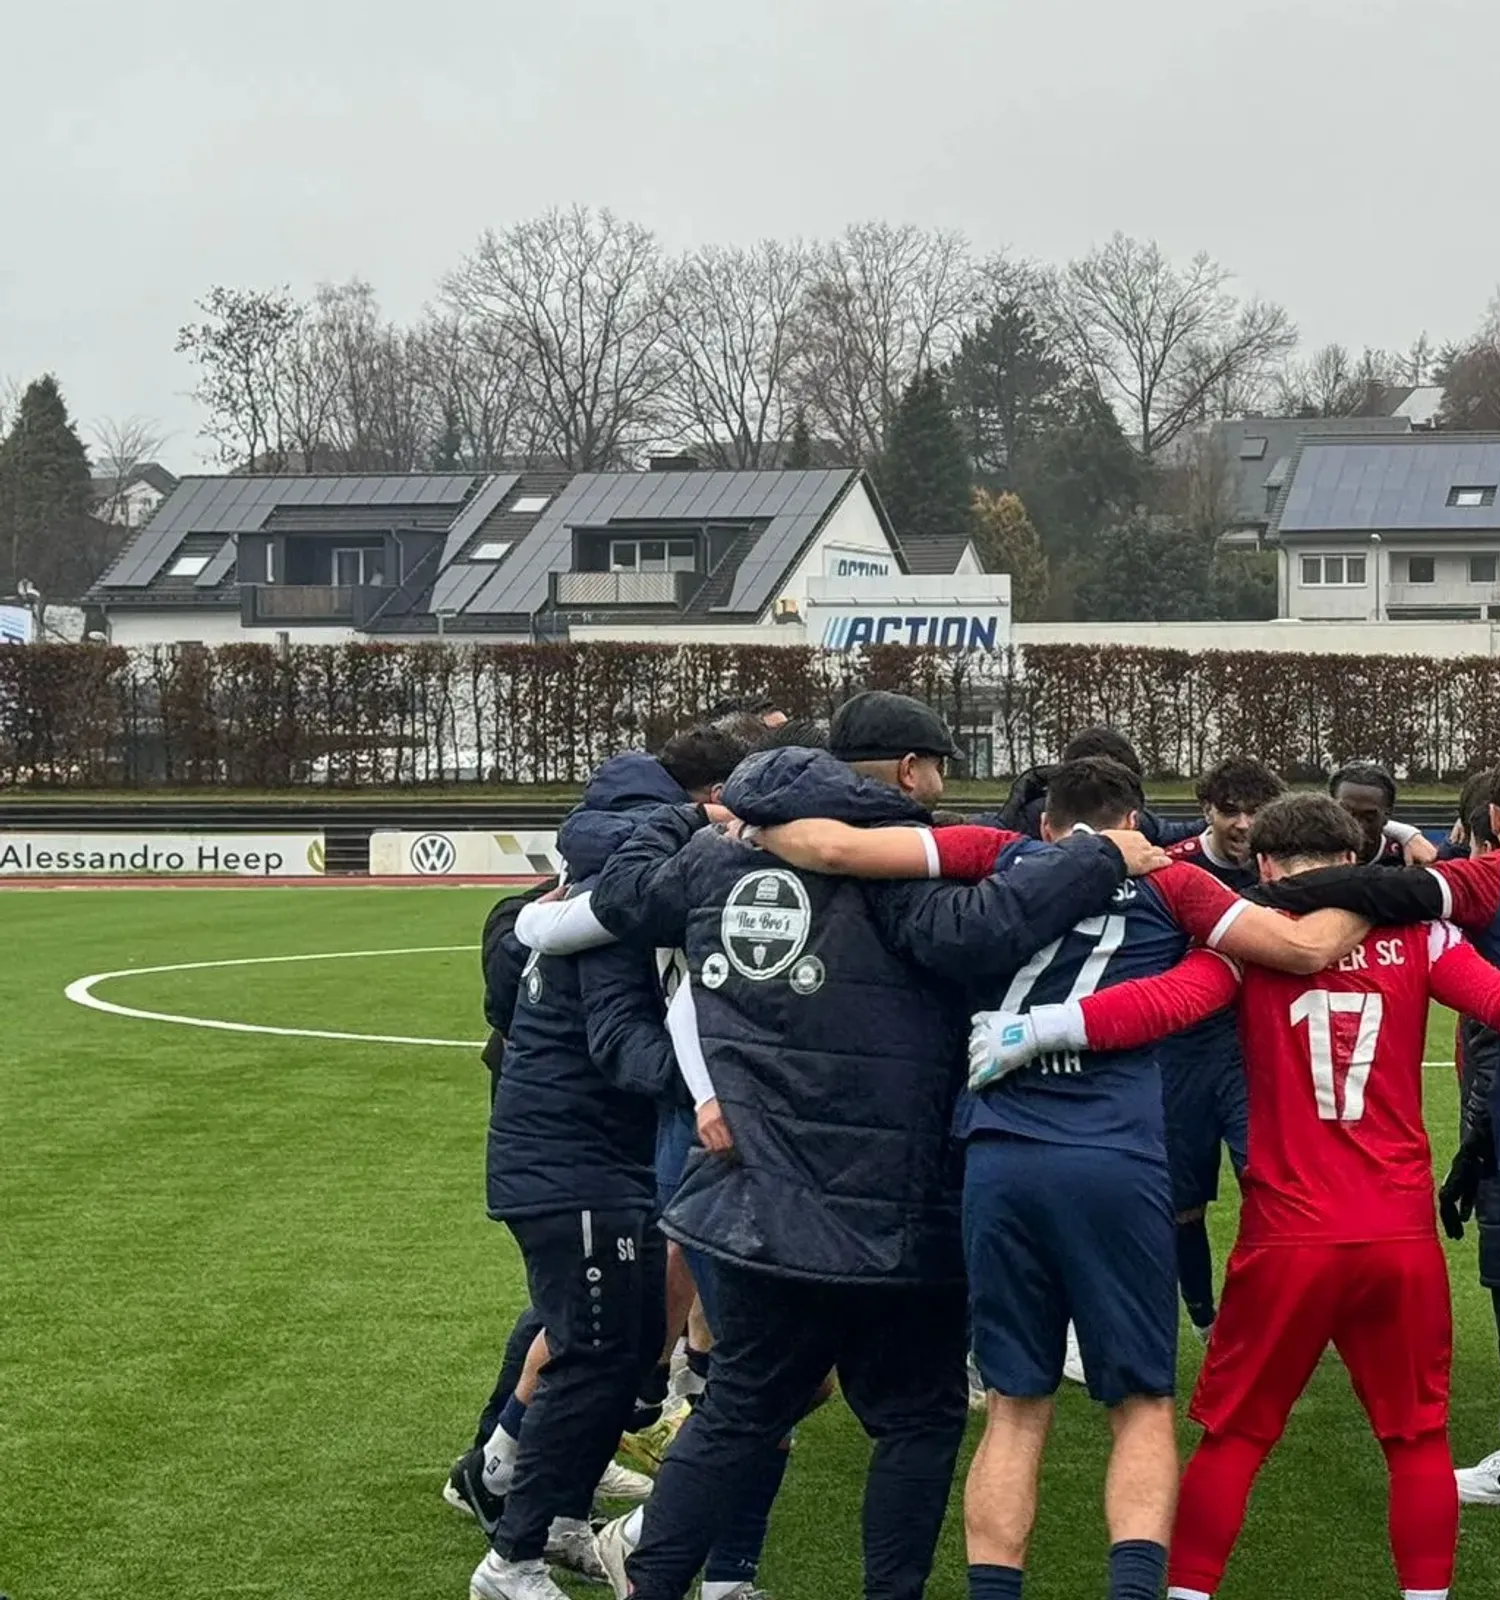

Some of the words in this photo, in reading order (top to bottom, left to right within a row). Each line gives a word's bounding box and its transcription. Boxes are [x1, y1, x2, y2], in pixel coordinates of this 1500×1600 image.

[844, 616, 999, 651] ACTION
[0, 843, 185, 870] Alessandro
[198, 846, 284, 875] Heep
[736, 911, 757, 929] The
[1375, 937, 1406, 966] SC
[1289, 988, 1384, 1121] 17
[616, 1236, 636, 1262] SG
